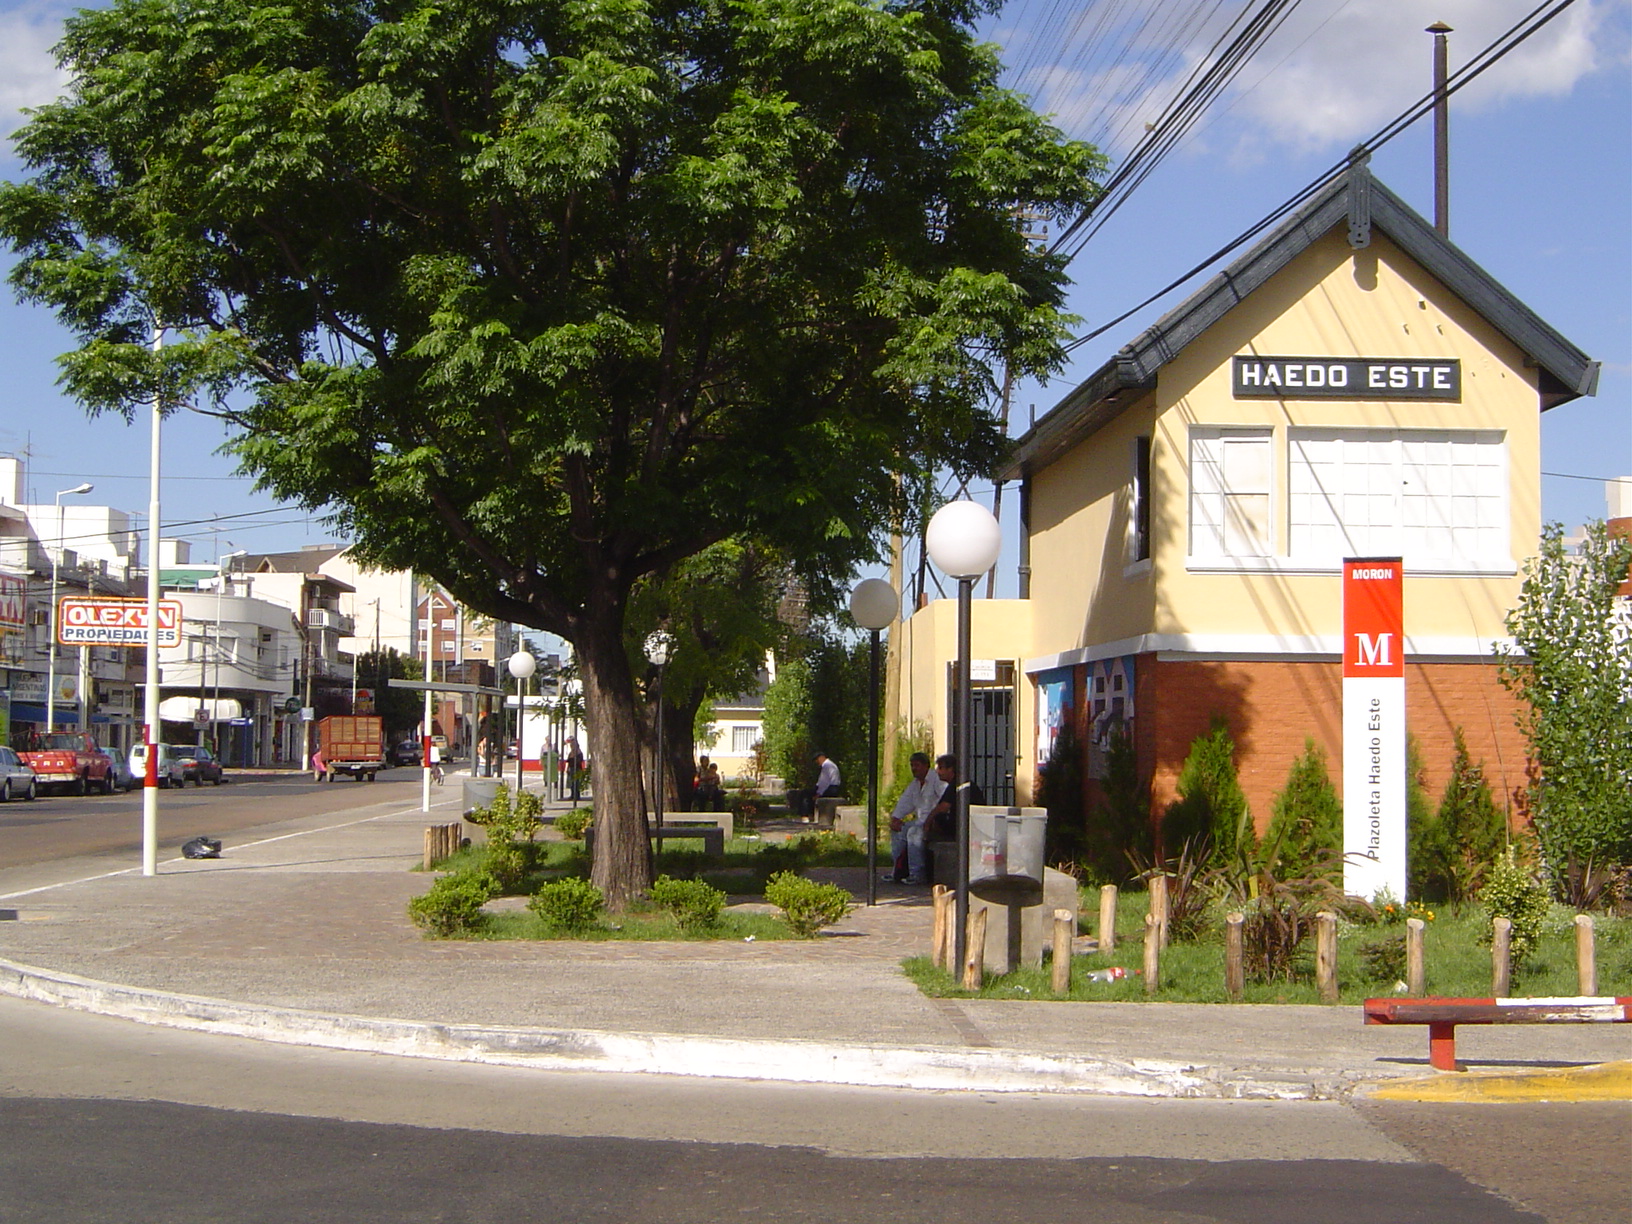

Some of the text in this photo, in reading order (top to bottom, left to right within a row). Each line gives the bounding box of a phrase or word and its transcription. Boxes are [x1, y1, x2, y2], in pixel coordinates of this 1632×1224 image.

[1241, 364, 1452, 390] HAEDO ESTE
[1352, 568, 1393, 580] MORON
[1354, 633, 1393, 666] M
[1367, 698, 1381, 861] Plazoleta Haedo Este
